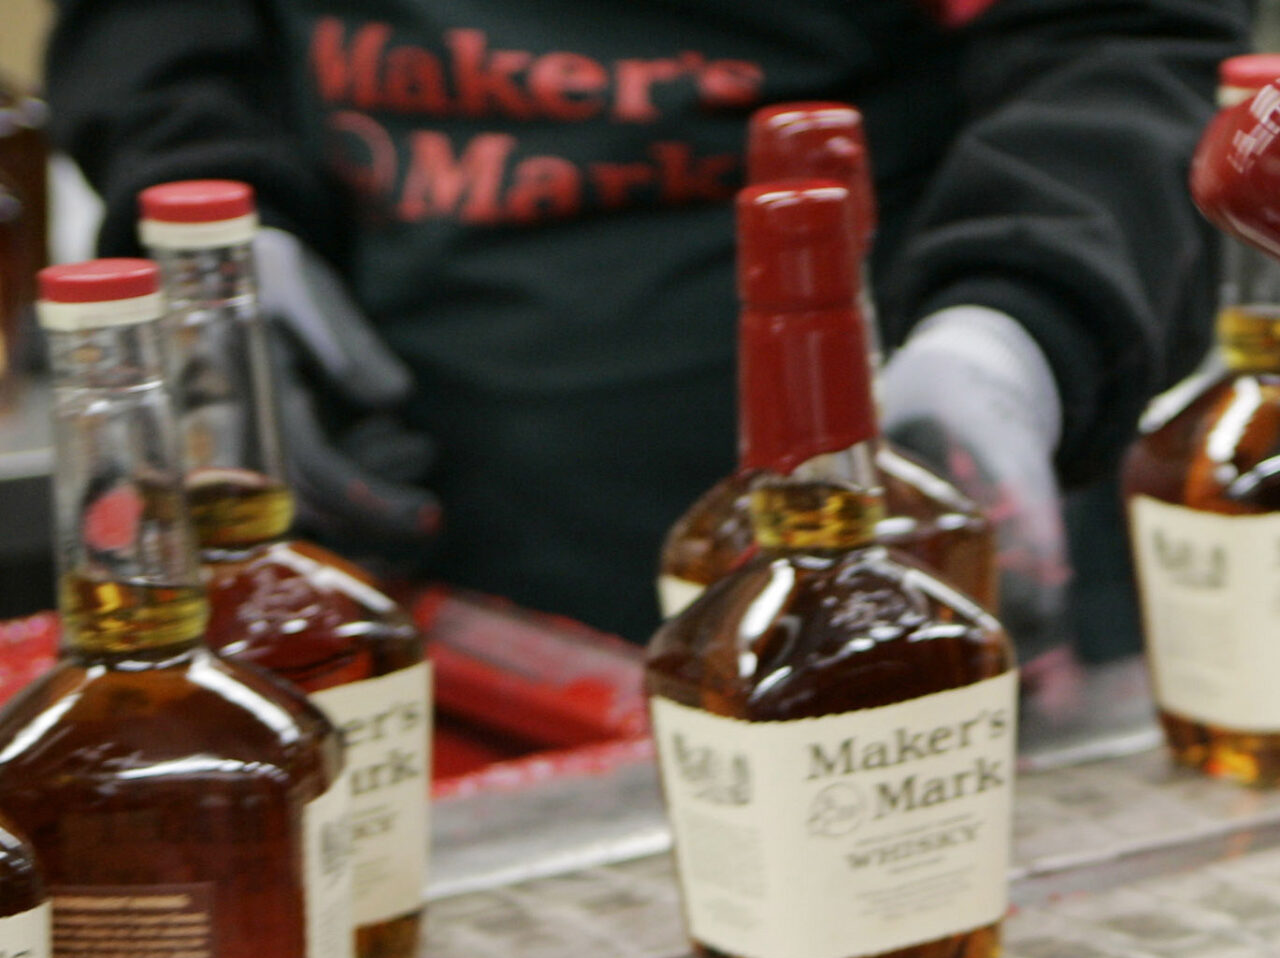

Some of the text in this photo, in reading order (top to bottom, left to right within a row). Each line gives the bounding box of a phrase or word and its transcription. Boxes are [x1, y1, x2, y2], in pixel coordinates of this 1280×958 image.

[310, 15, 766, 122] Maker's
[402, 129, 740, 225] Mark
[806, 707, 1007, 781] Maker's
[872, 756, 1005, 822] Mark
